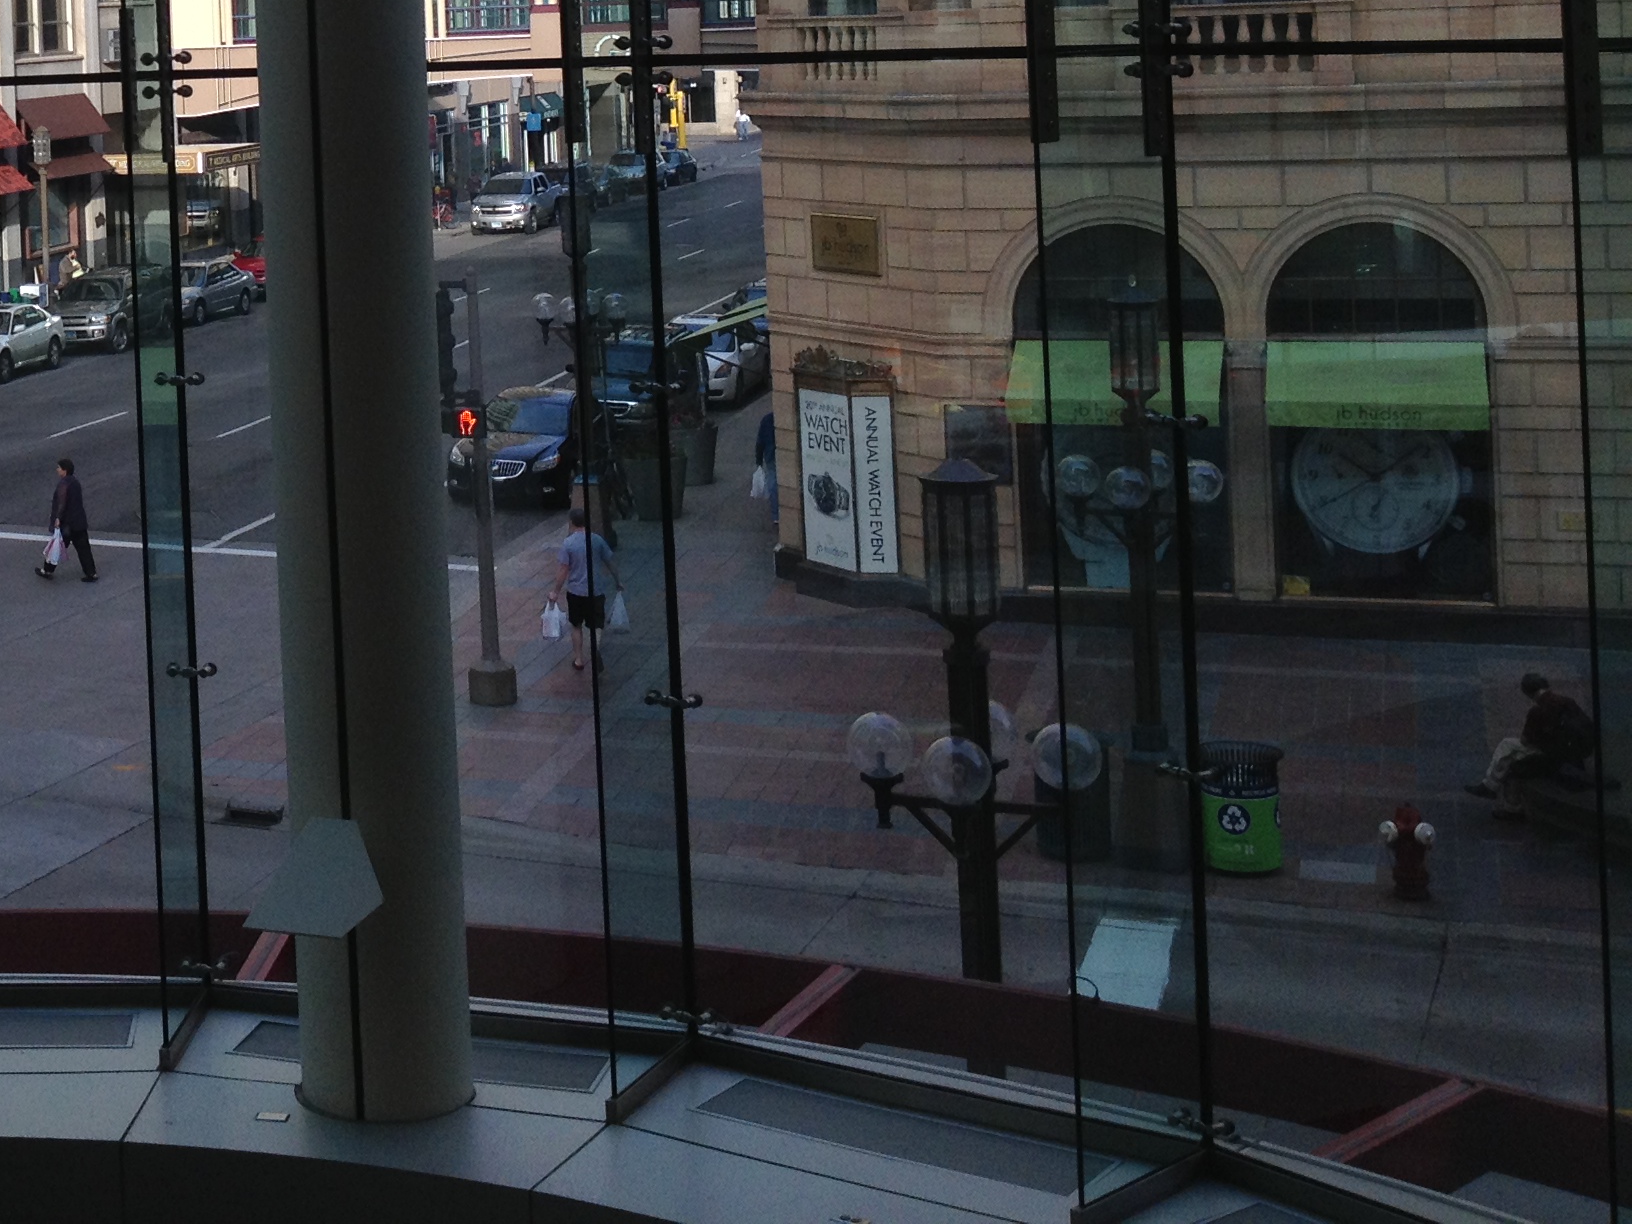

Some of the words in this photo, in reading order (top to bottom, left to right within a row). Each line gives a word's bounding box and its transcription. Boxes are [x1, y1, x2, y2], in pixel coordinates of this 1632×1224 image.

[804, 412, 848, 437] WATCH
[1358, 404, 1422, 421] hudson
[808, 431, 846, 455] EVENT
[865, 406, 879, 464] ANNUAL
[868, 468, 882, 518] WATCH
[870, 520, 885, 564] EVENT
